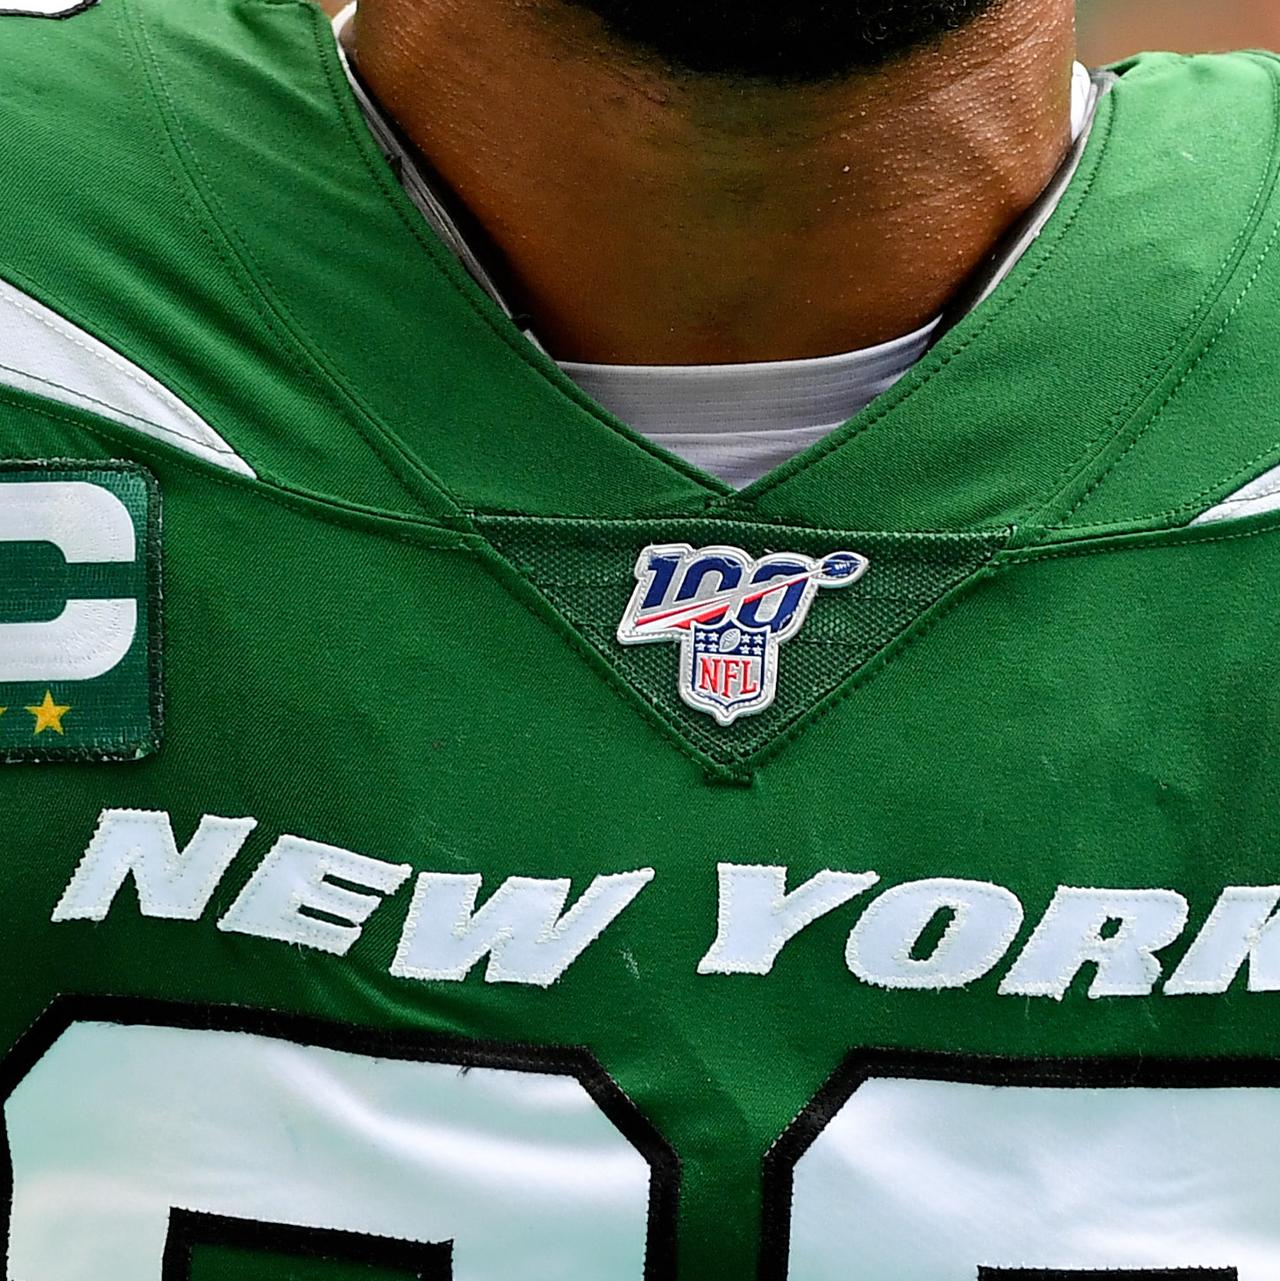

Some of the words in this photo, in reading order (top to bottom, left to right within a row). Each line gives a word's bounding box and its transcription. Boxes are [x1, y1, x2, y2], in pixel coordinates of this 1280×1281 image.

[639, 553, 811, 634] 100
[698, 655, 759, 699] NFL
[51, 808, 655, 989] NEW
